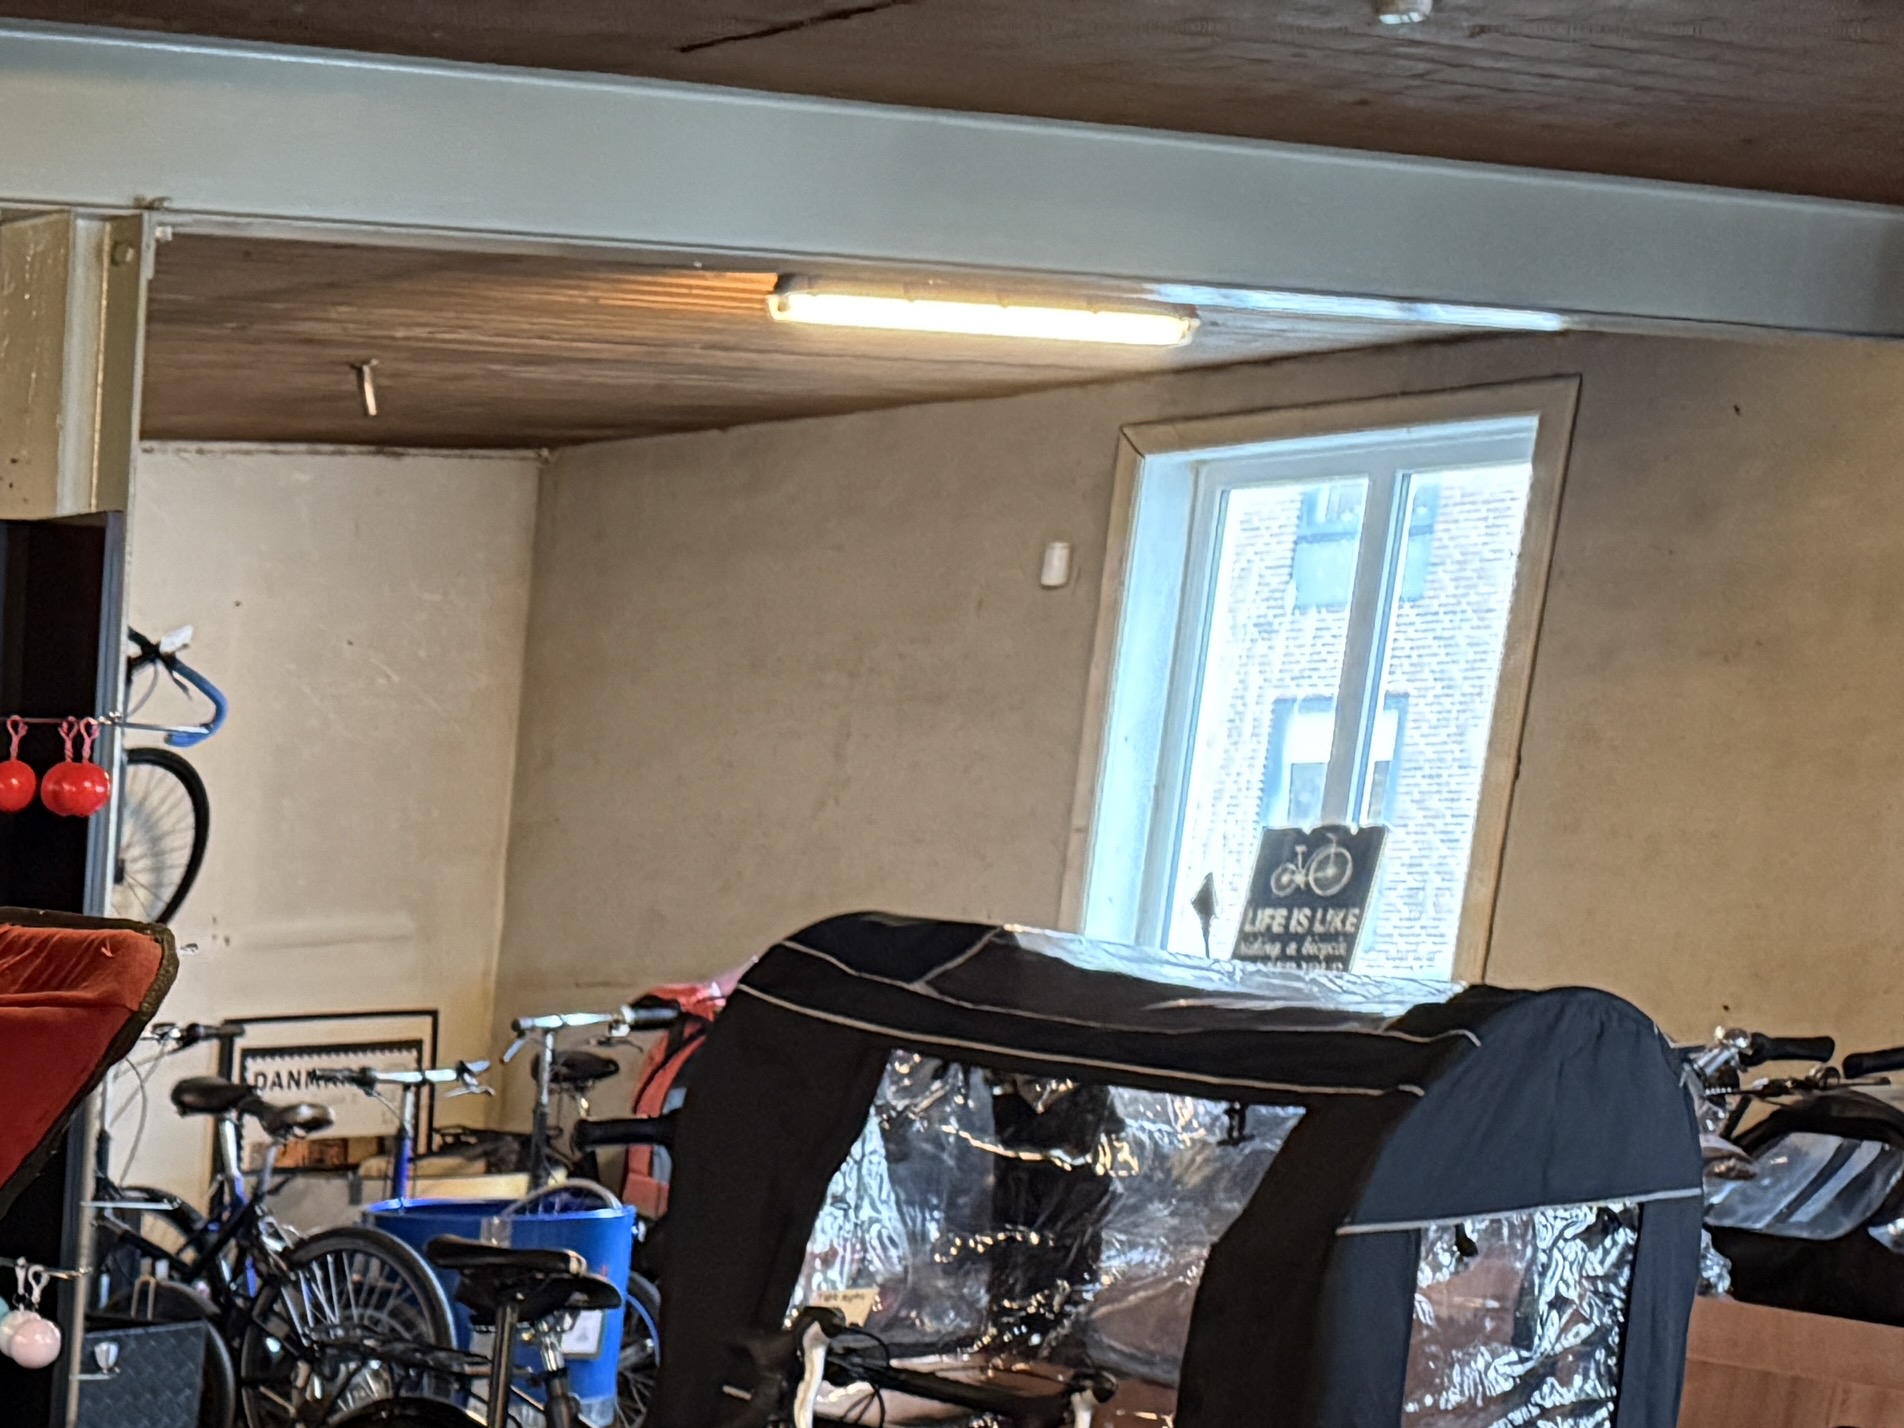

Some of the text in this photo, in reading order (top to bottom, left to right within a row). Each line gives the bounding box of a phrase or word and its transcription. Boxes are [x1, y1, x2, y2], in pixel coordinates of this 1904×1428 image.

[1243, 906, 1360, 934] LIFE IS LIKE
[1285, 941, 1298, 957] a
